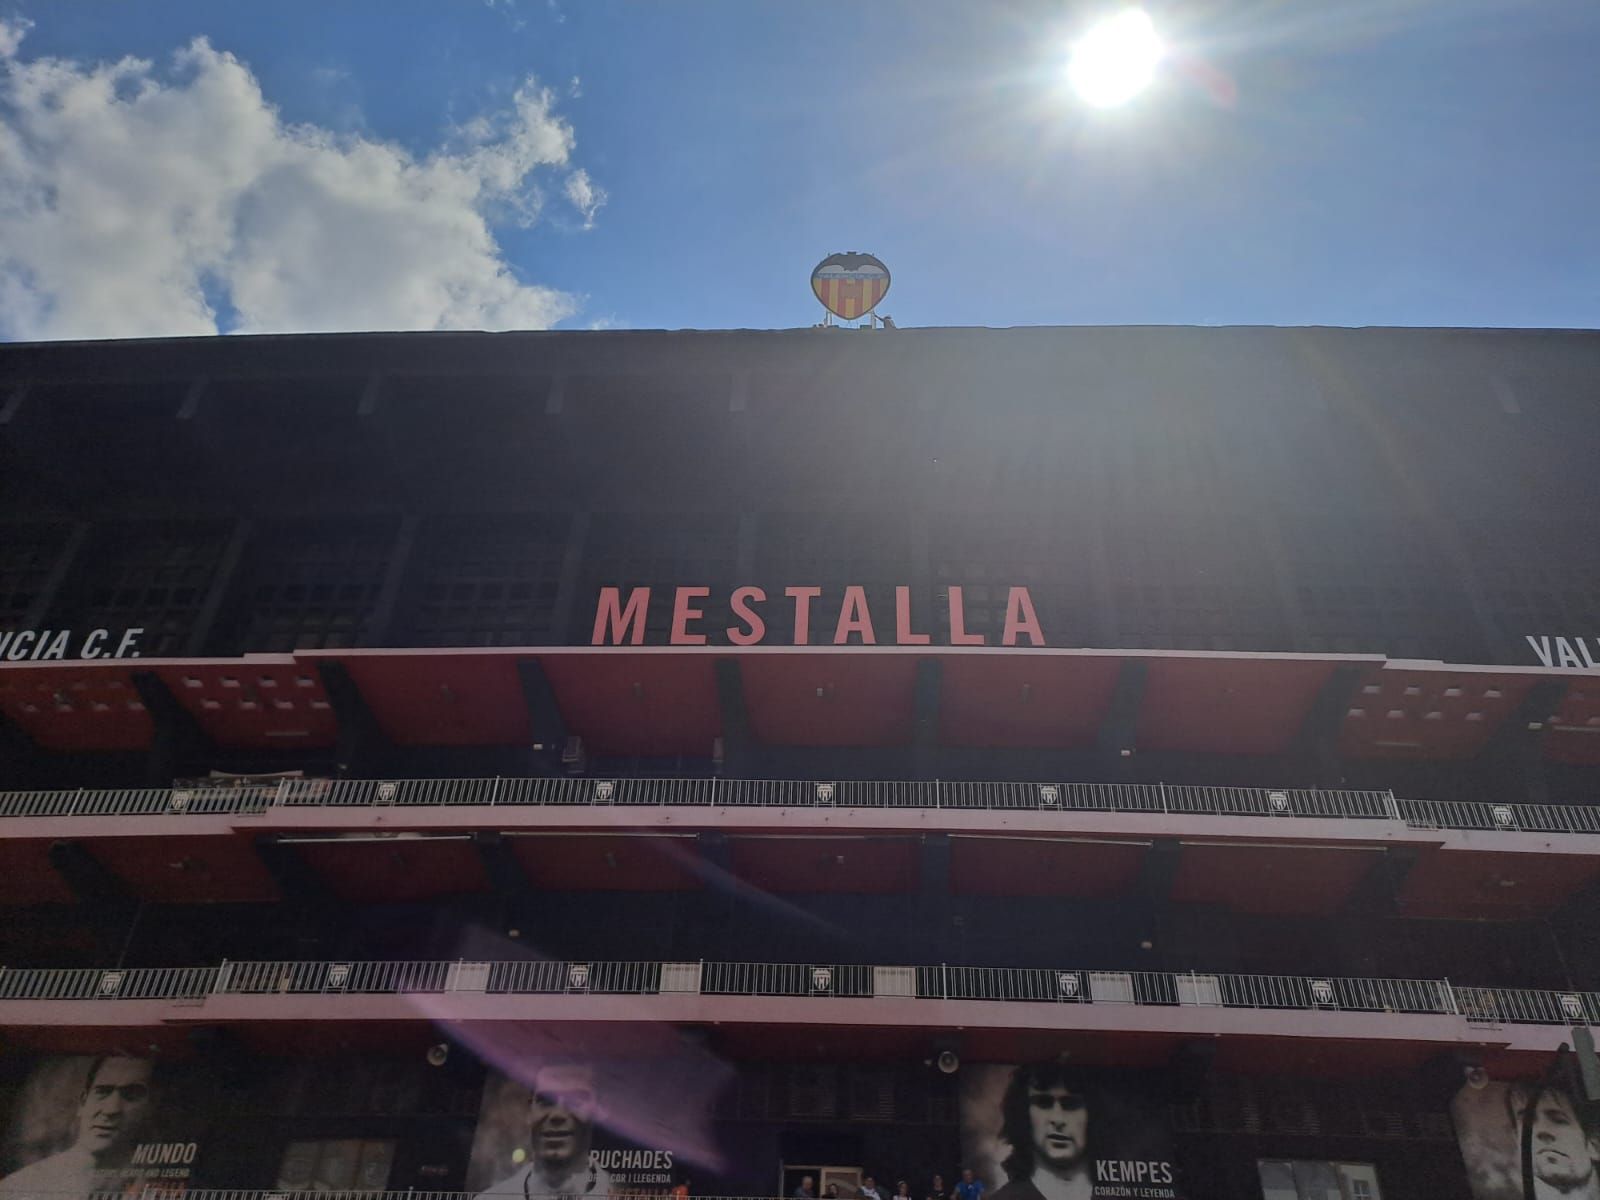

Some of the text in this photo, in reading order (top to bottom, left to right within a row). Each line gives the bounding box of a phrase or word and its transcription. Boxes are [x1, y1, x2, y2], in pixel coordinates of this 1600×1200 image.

[591, 585, 1046, 646] MESTALLA
[80, 628, 144, 659] C.F.
[1525, 635, 1600, 668] VAL
[130, 1142, 197, 1164] MUNDO
[588, 1150, 673, 1170] PUCHADES
[610, 1173, 626, 1183] COR
[633, 1173, 671, 1183] LLEGENDA
[1096, 1160, 1173, 1184] KEMPES
[1133, 1187, 1139, 1197] Y
[1140, 1187, 1175, 1199] LEYENDA
